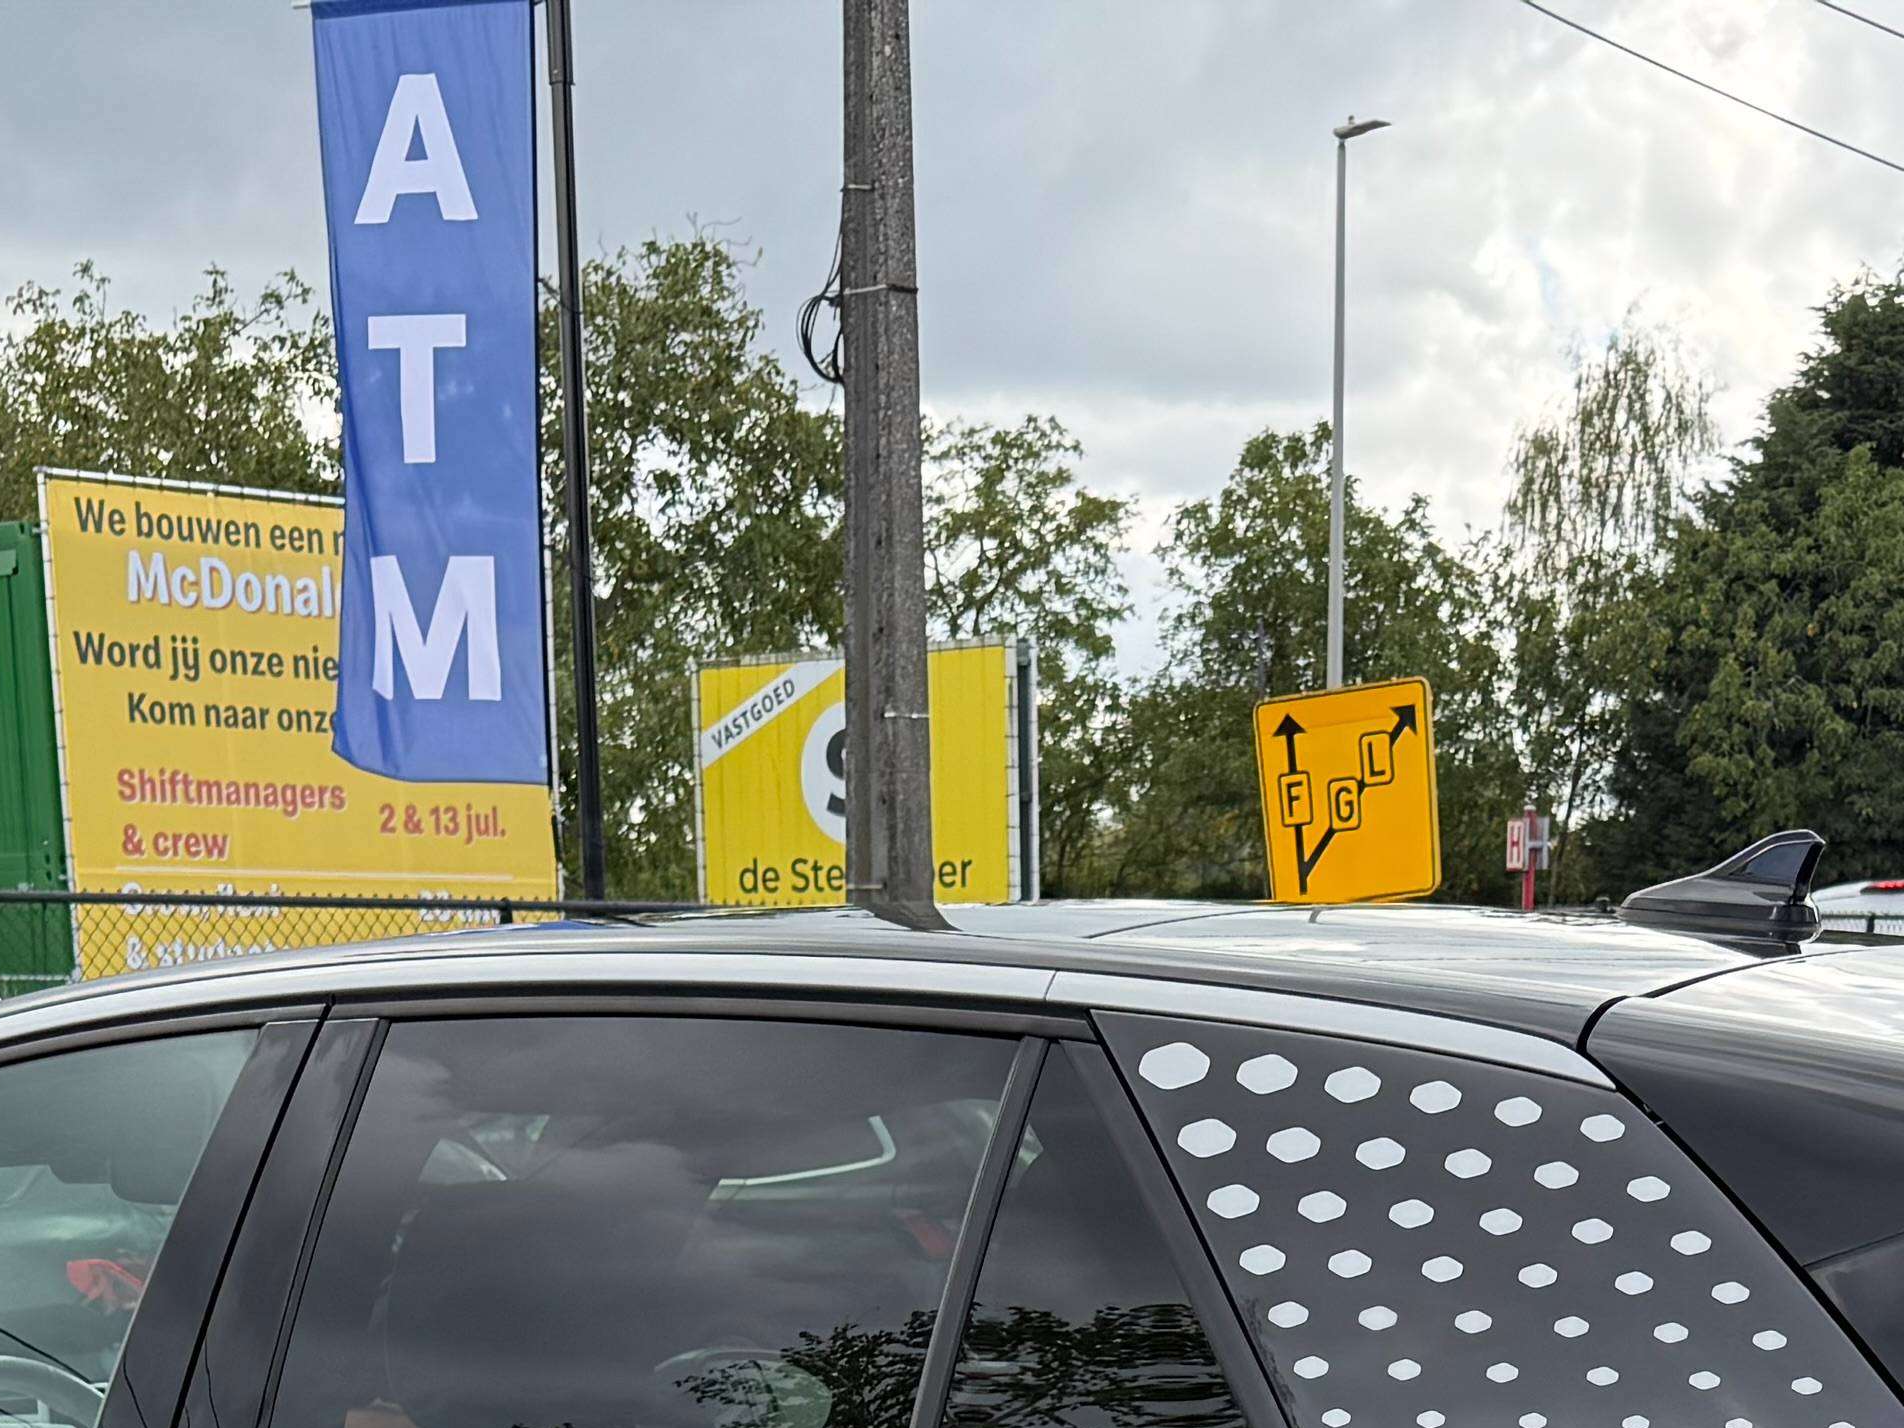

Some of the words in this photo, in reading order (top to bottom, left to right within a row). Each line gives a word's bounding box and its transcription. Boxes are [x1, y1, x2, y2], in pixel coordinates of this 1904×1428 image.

[354, 73, 502, 700] ATM
[75, 497, 126, 536] We
[135, 501, 261, 549] bouwen
[269, 524, 324, 555] een
[73, 631, 161, 670] Word
[209, 648, 284, 678] onze
[128, 692, 195, 726] Kom
[205, 703, 269, 730] naar
[711, 679, 796, 750] VASTGOED
[1369, 741, 1386, 777] L
[117, 768, 346, 817] Shiftmanagers
[1286, 782, 1302, 817] F
[1335, 787, 1353, 822] G
[122, 823, 144, 857] &
[152, 830, 229, 860] crew
[379, 803, 396, 834] 2
[403, 806, 423, 835] &
[429, 806, 459, 836] 13
[464, 805, 507, 845] jul.
[739, 857, 780, 893] de
